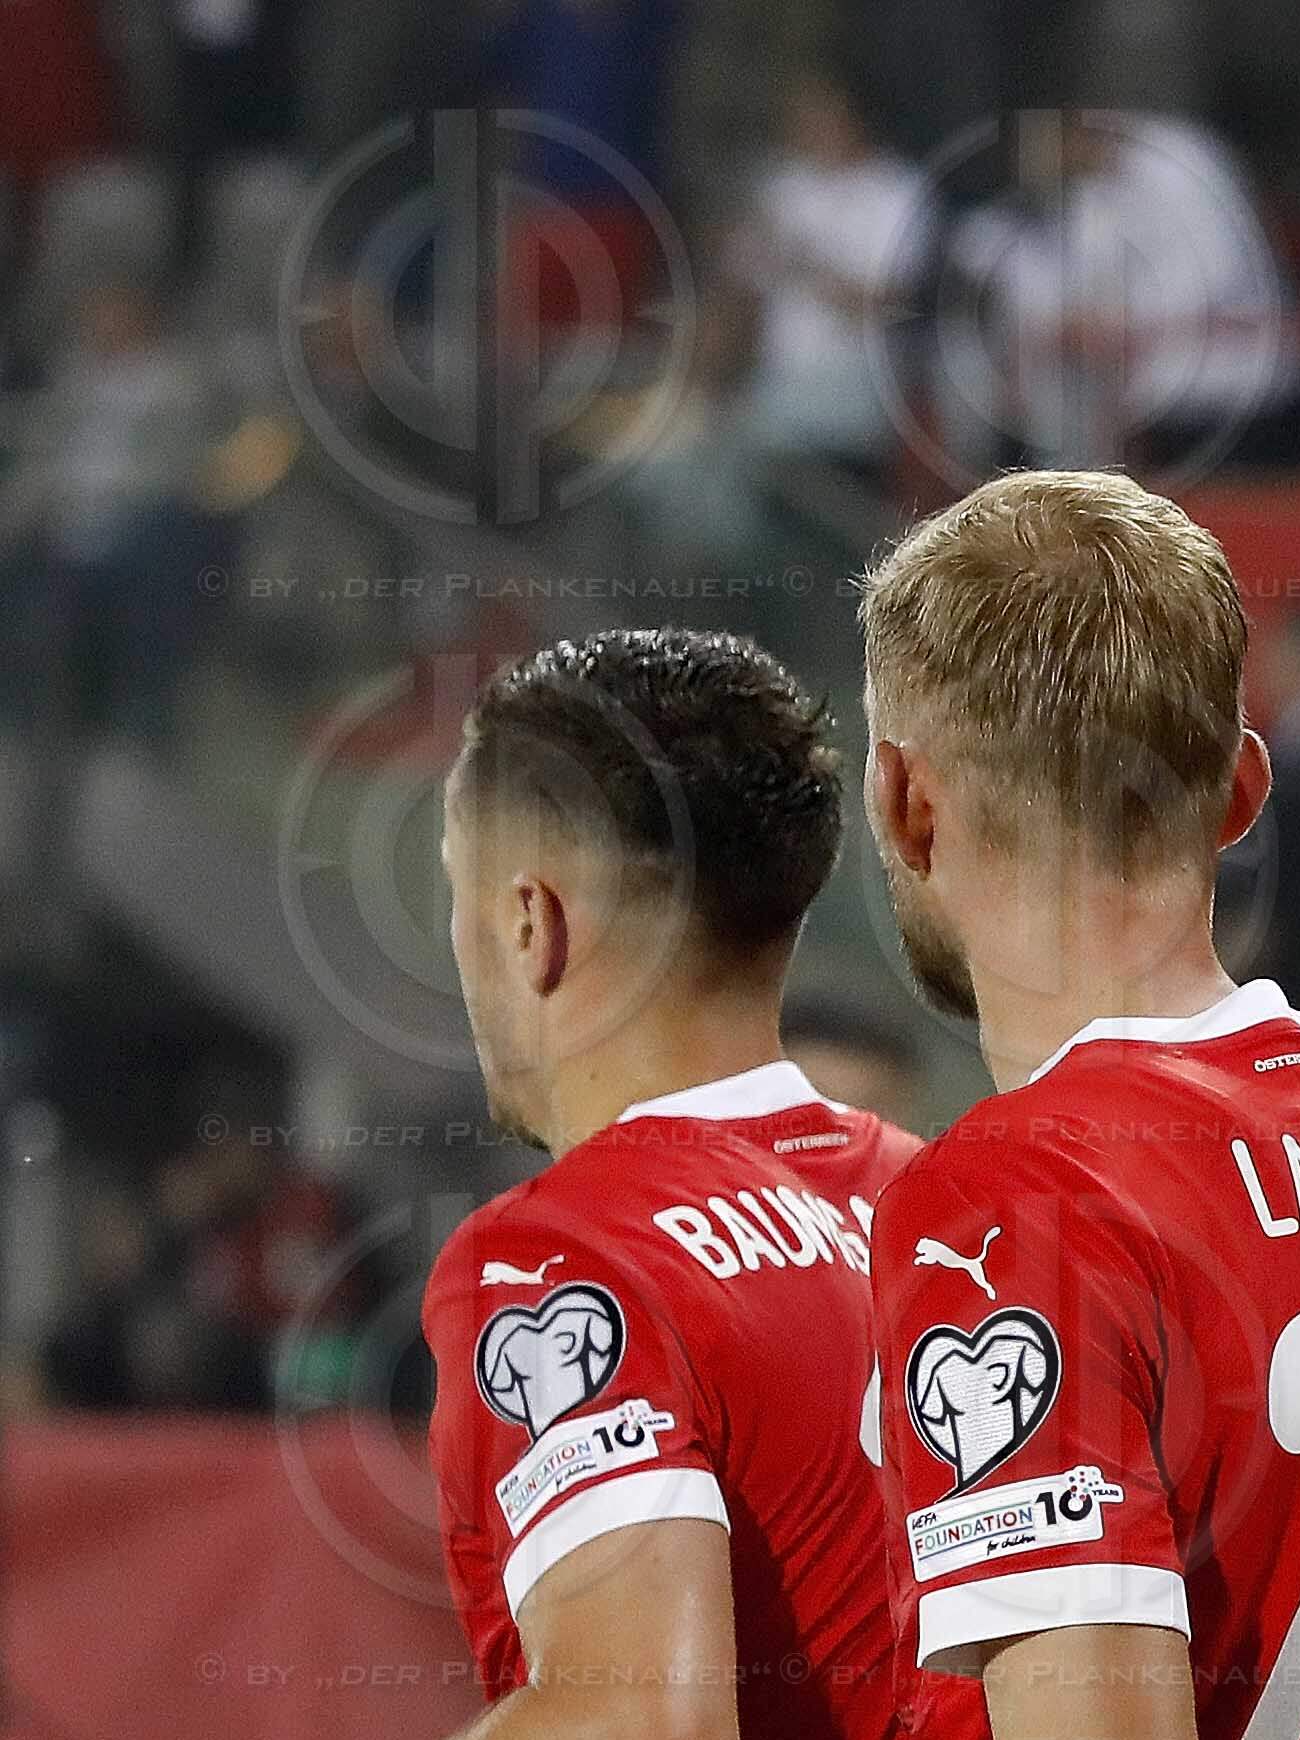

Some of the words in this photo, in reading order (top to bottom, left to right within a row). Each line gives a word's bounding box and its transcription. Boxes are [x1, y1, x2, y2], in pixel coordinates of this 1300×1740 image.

[912, 1512, 937, 1530] UEFA
[915, 1506, 1033, 1556] FOUNDATION
[986, 1539, 999, 1556] for
